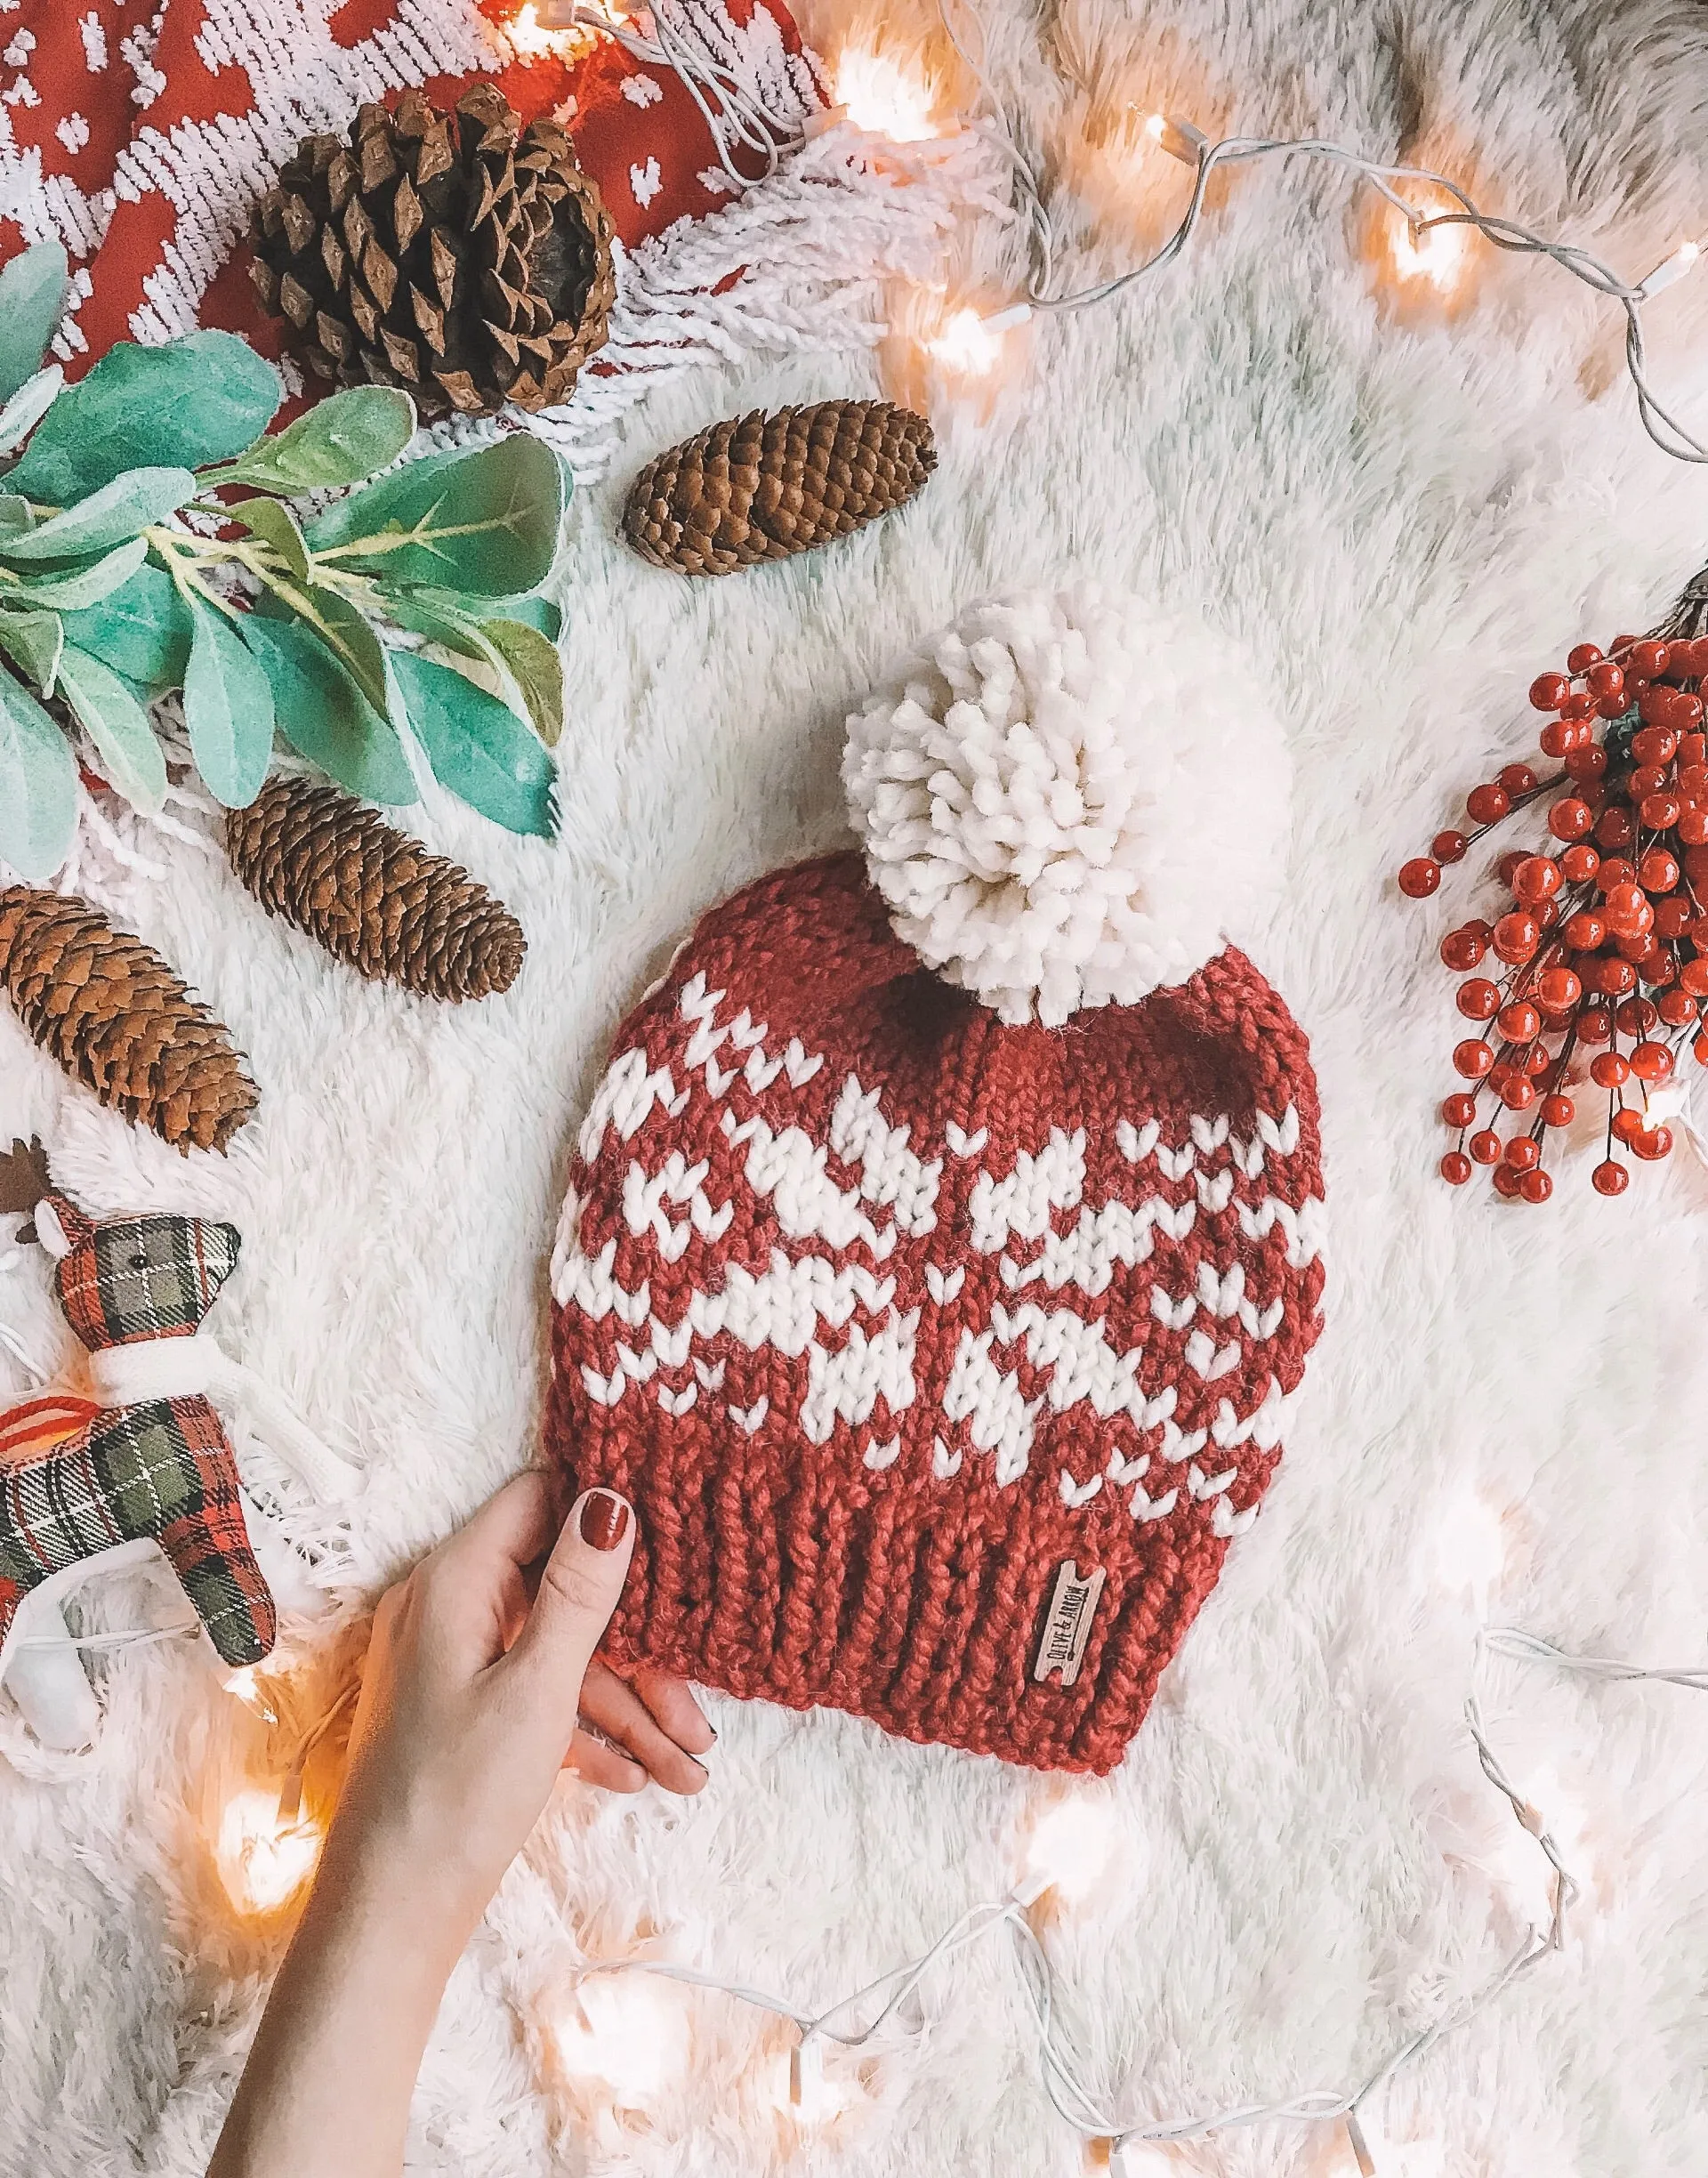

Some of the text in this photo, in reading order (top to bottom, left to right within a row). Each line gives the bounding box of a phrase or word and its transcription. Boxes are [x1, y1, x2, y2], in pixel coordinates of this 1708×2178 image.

[1047, 1585, 1084, 1659] OLIVE & ARROW
